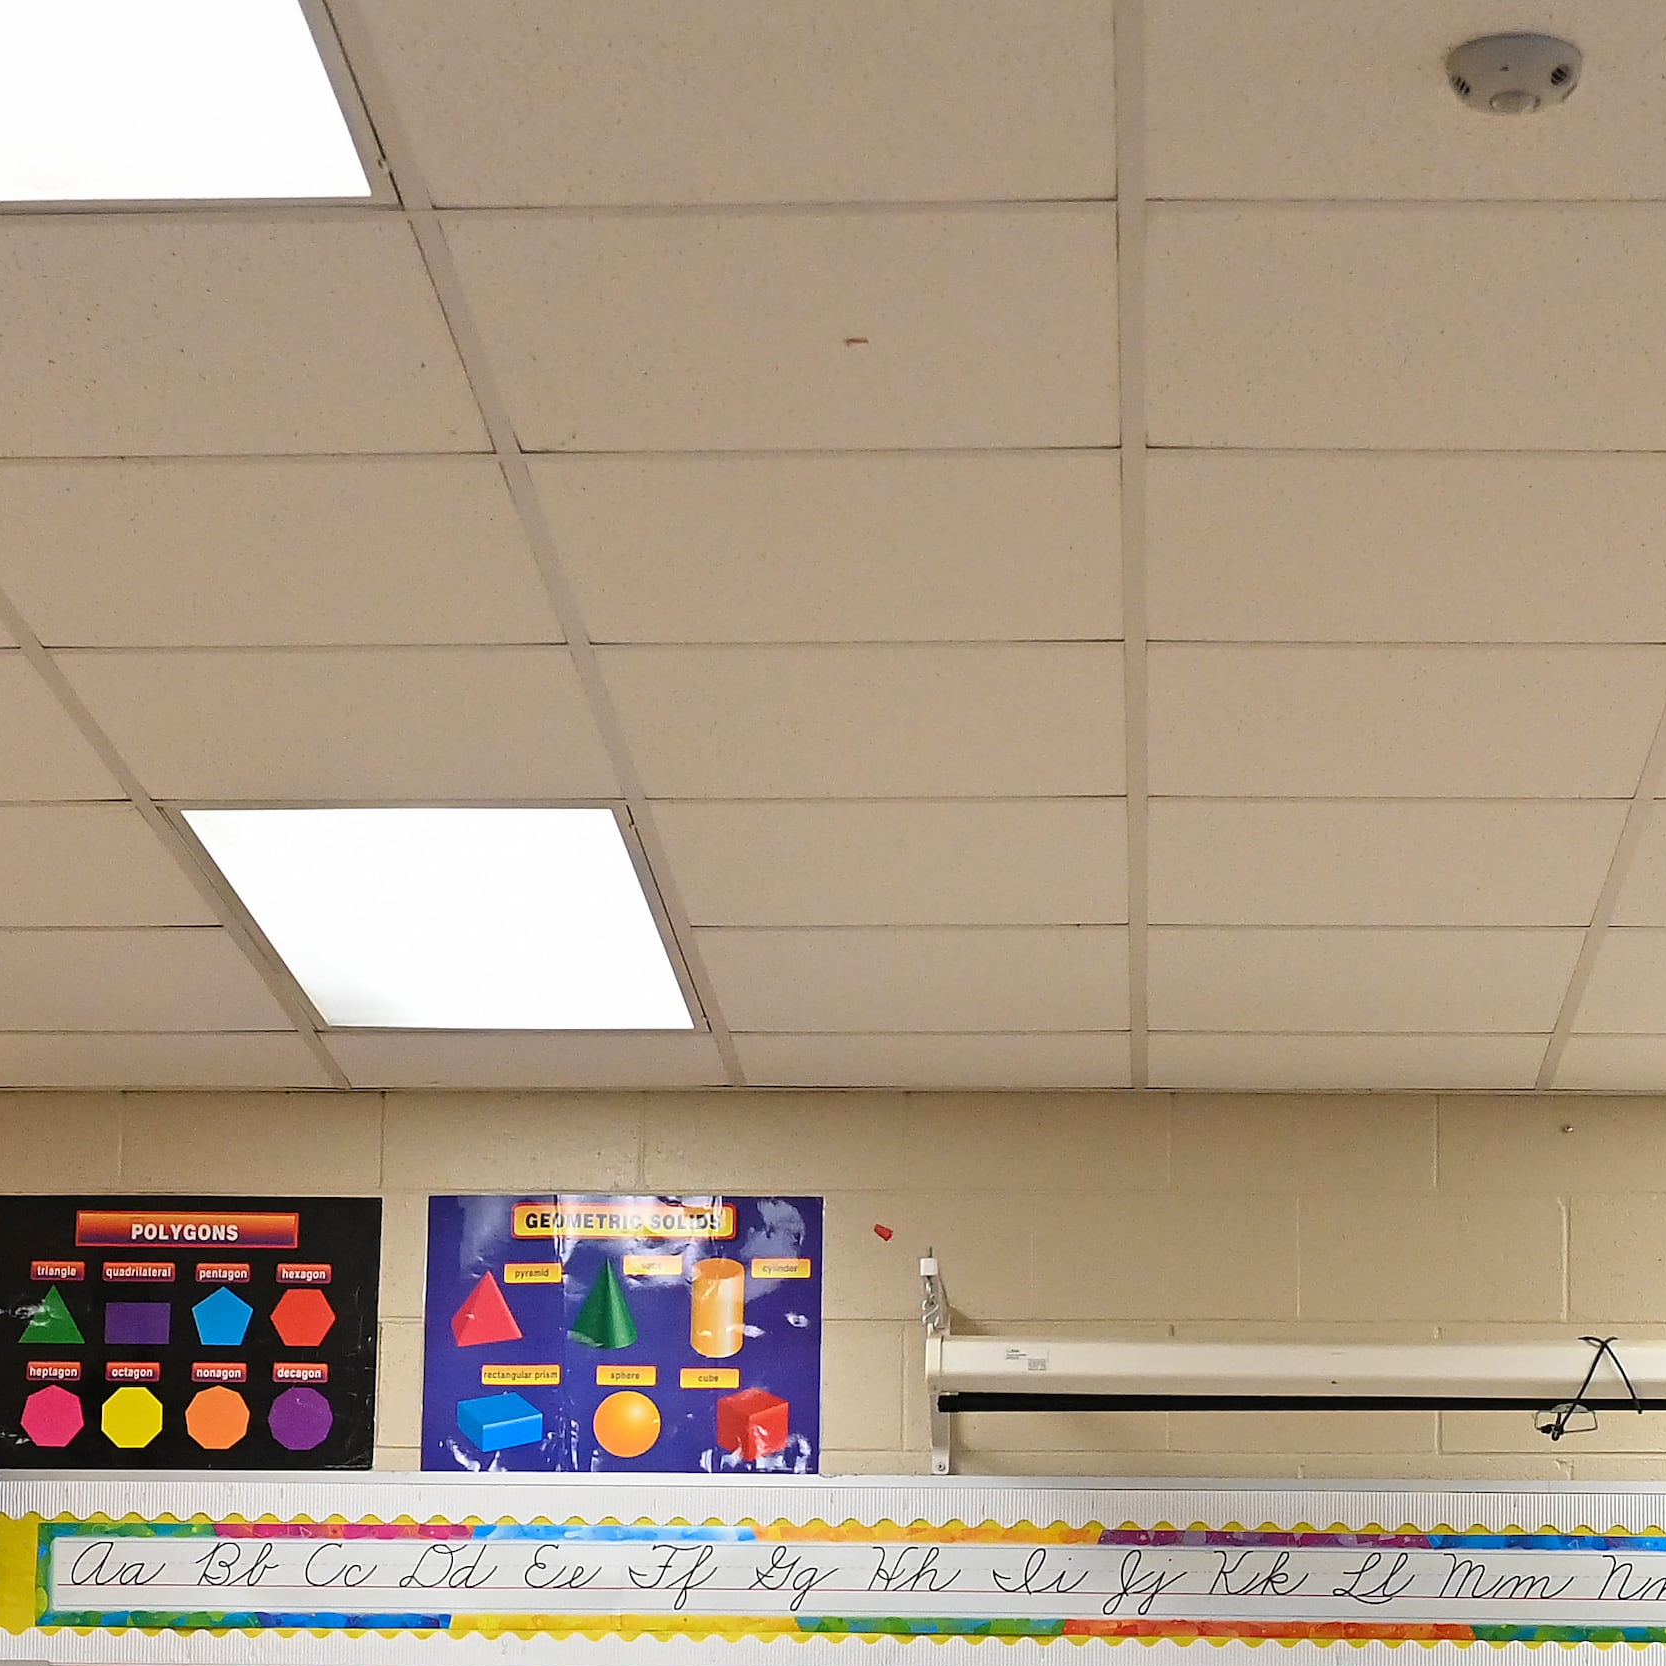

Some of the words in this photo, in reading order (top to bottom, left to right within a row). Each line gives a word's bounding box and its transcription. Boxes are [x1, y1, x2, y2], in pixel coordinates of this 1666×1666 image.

[525, 1212, 642, 1229] GEOMETRIC
[649, 1214, 721, 1231] SOLIDS
[131, 1223, 239, 1242] POLYGONS
[37, 1265, 76, 1278] triangle
[105, 1266, 171, 1279] quadrilateral
[199, 1267, 248, 1281] pentagon
[281, 1268, 326, 1282] hexagon
[514, 1267, 549, 1279] pyramid
[29, 1366, 78, 1379] heptagon
[111, 1366, 153, 1379] octagon
[196, 1367, 242, 1380] nonagon
[277, 1368, 321, 1381] decagon
[483, 1369, 533, 1381] rectangular
[534, 1370, 559, 1382] prism
[609, 1370, 640, 1382] sphere
[697, 1373, 719, 1383] cube
[71, 1541, 172, 1586] Aa
[195, 1542, 291, 1586] Bb
[304, 1543, 376, 1588] Cc
[399, 1543, 500, 1589] Dd
[524, 1544, 602, 1589] Ee
[628, 1544, 718, 1610] Ff
[748, 1546, 839, 1611] Gg
[867, 1546, 963, 1592] Hh
[992, 1548, 1088, 1593] Ii
[1102, 1549, 1188, 1614] Jj
[1210, 1550, 1310, 1596] Kk
[1333, 1552, 1416, 1604] Ll
[1439, 1552, 1574, 1599] Mm
